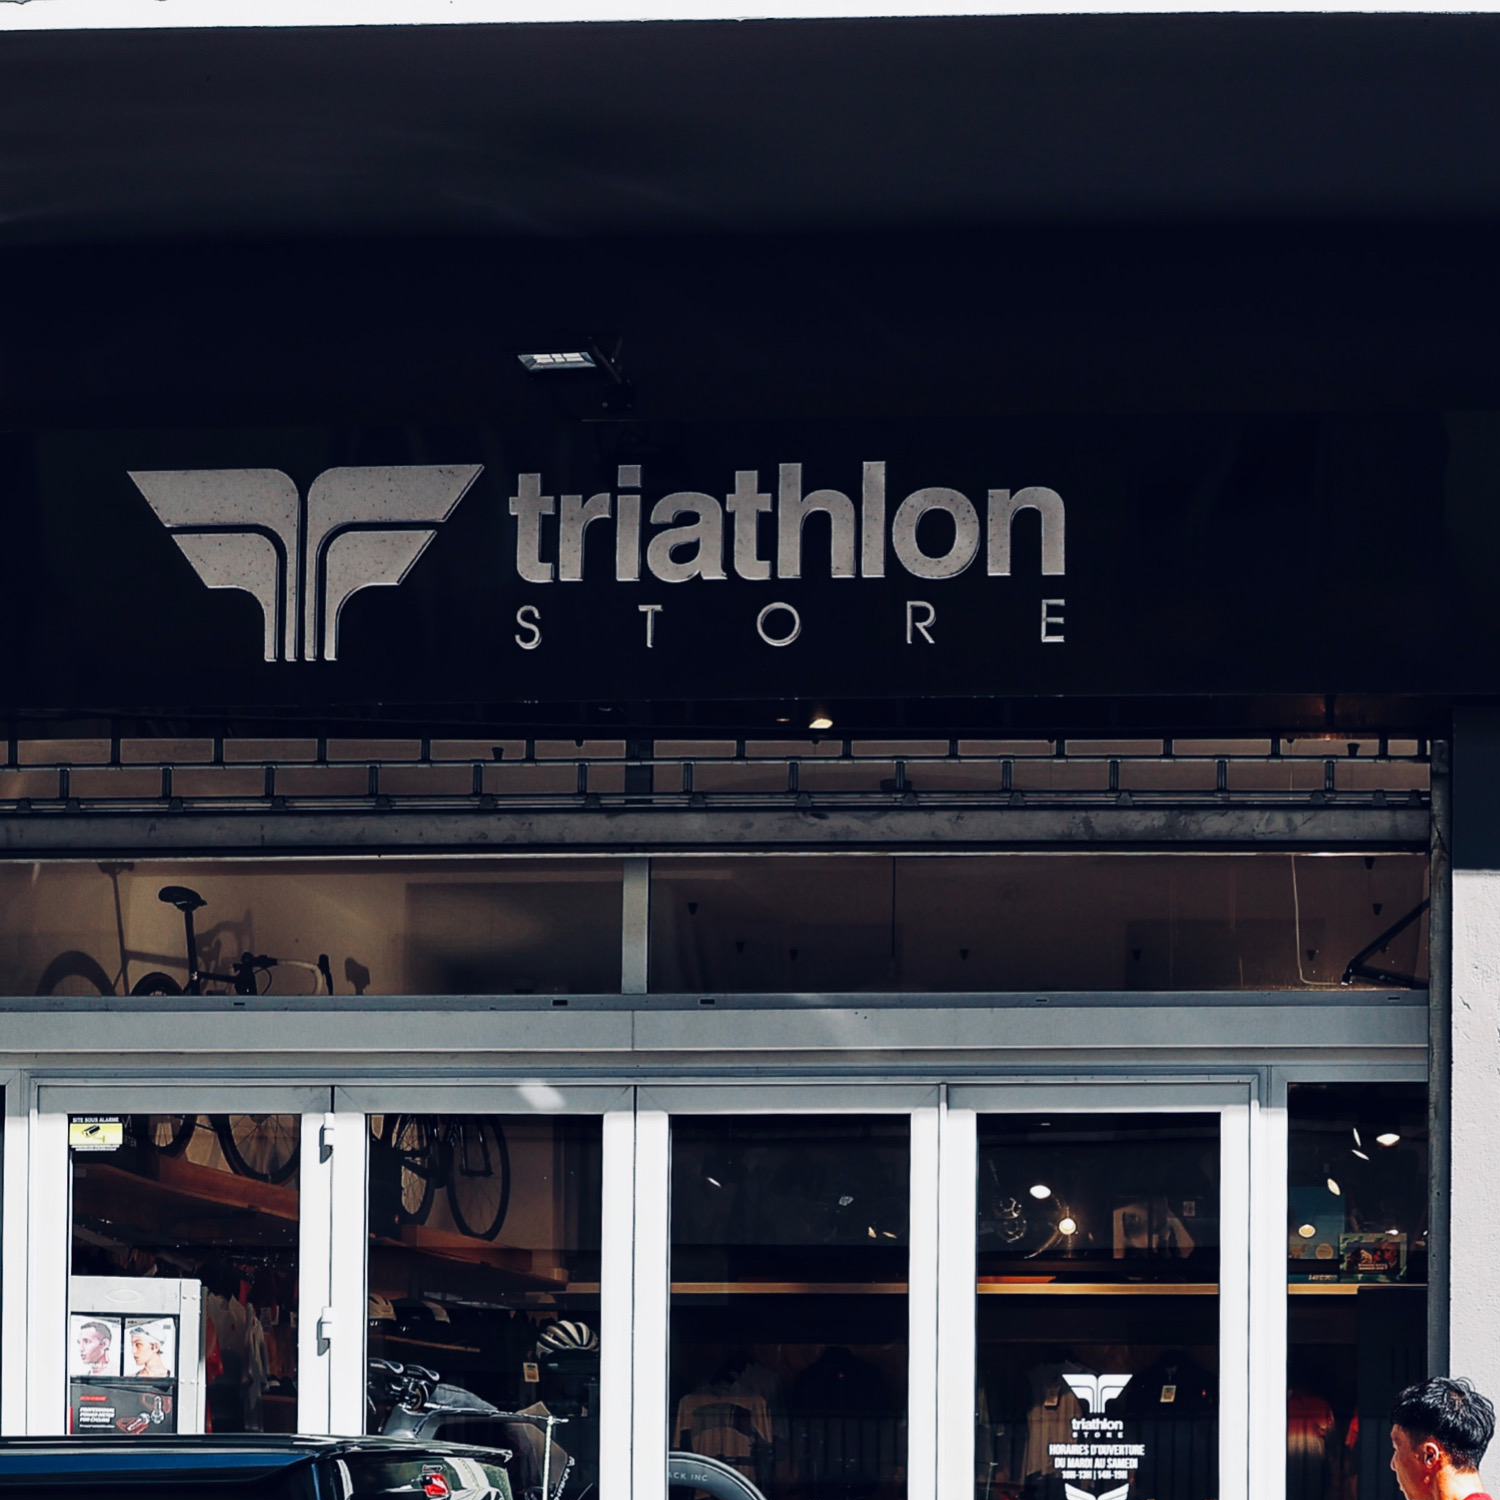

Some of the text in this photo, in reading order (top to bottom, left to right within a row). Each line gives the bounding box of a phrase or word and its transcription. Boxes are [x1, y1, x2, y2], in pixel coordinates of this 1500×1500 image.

[509, 460, 1066, 584] triathlon
[516, 599, 1066, 649] STORE
[1072, 1417, 1124, 1430] triathlon
[1049, 1444, 1146, 1456] HORAIRES D'OUVERTURE
[1054, 1457, 1138, 1469] DU MARDI AU SAMEDI
